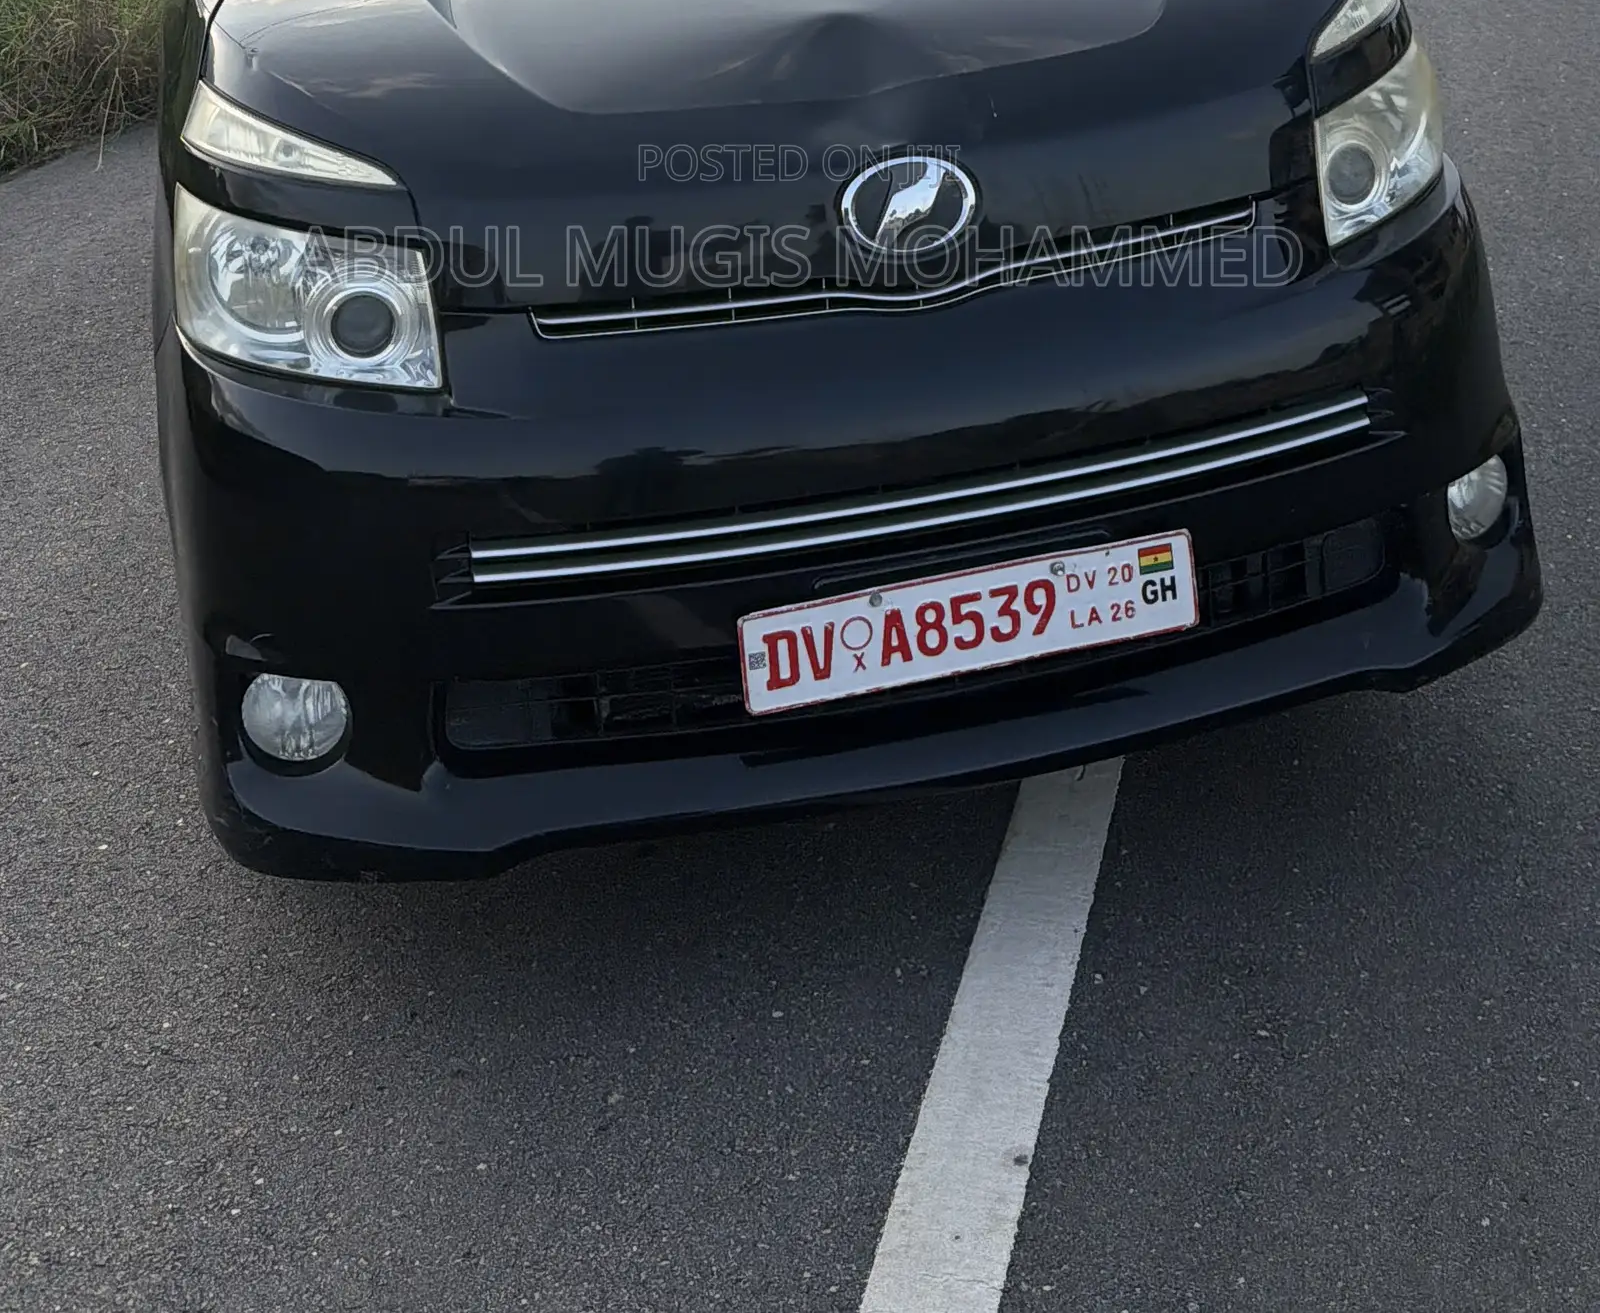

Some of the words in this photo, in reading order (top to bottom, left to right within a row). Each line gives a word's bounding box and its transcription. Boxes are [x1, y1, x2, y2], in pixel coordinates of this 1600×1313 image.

[1065, 569, 1097, 593] DV
[1107, 562, 1134, 586] 20
[1141, 574, 1178, 605] GH
[881, 578, 1057, 667] A8539
[1069, 605, 1103, 629] LA
[1110, 599, 1137, 623] 26
